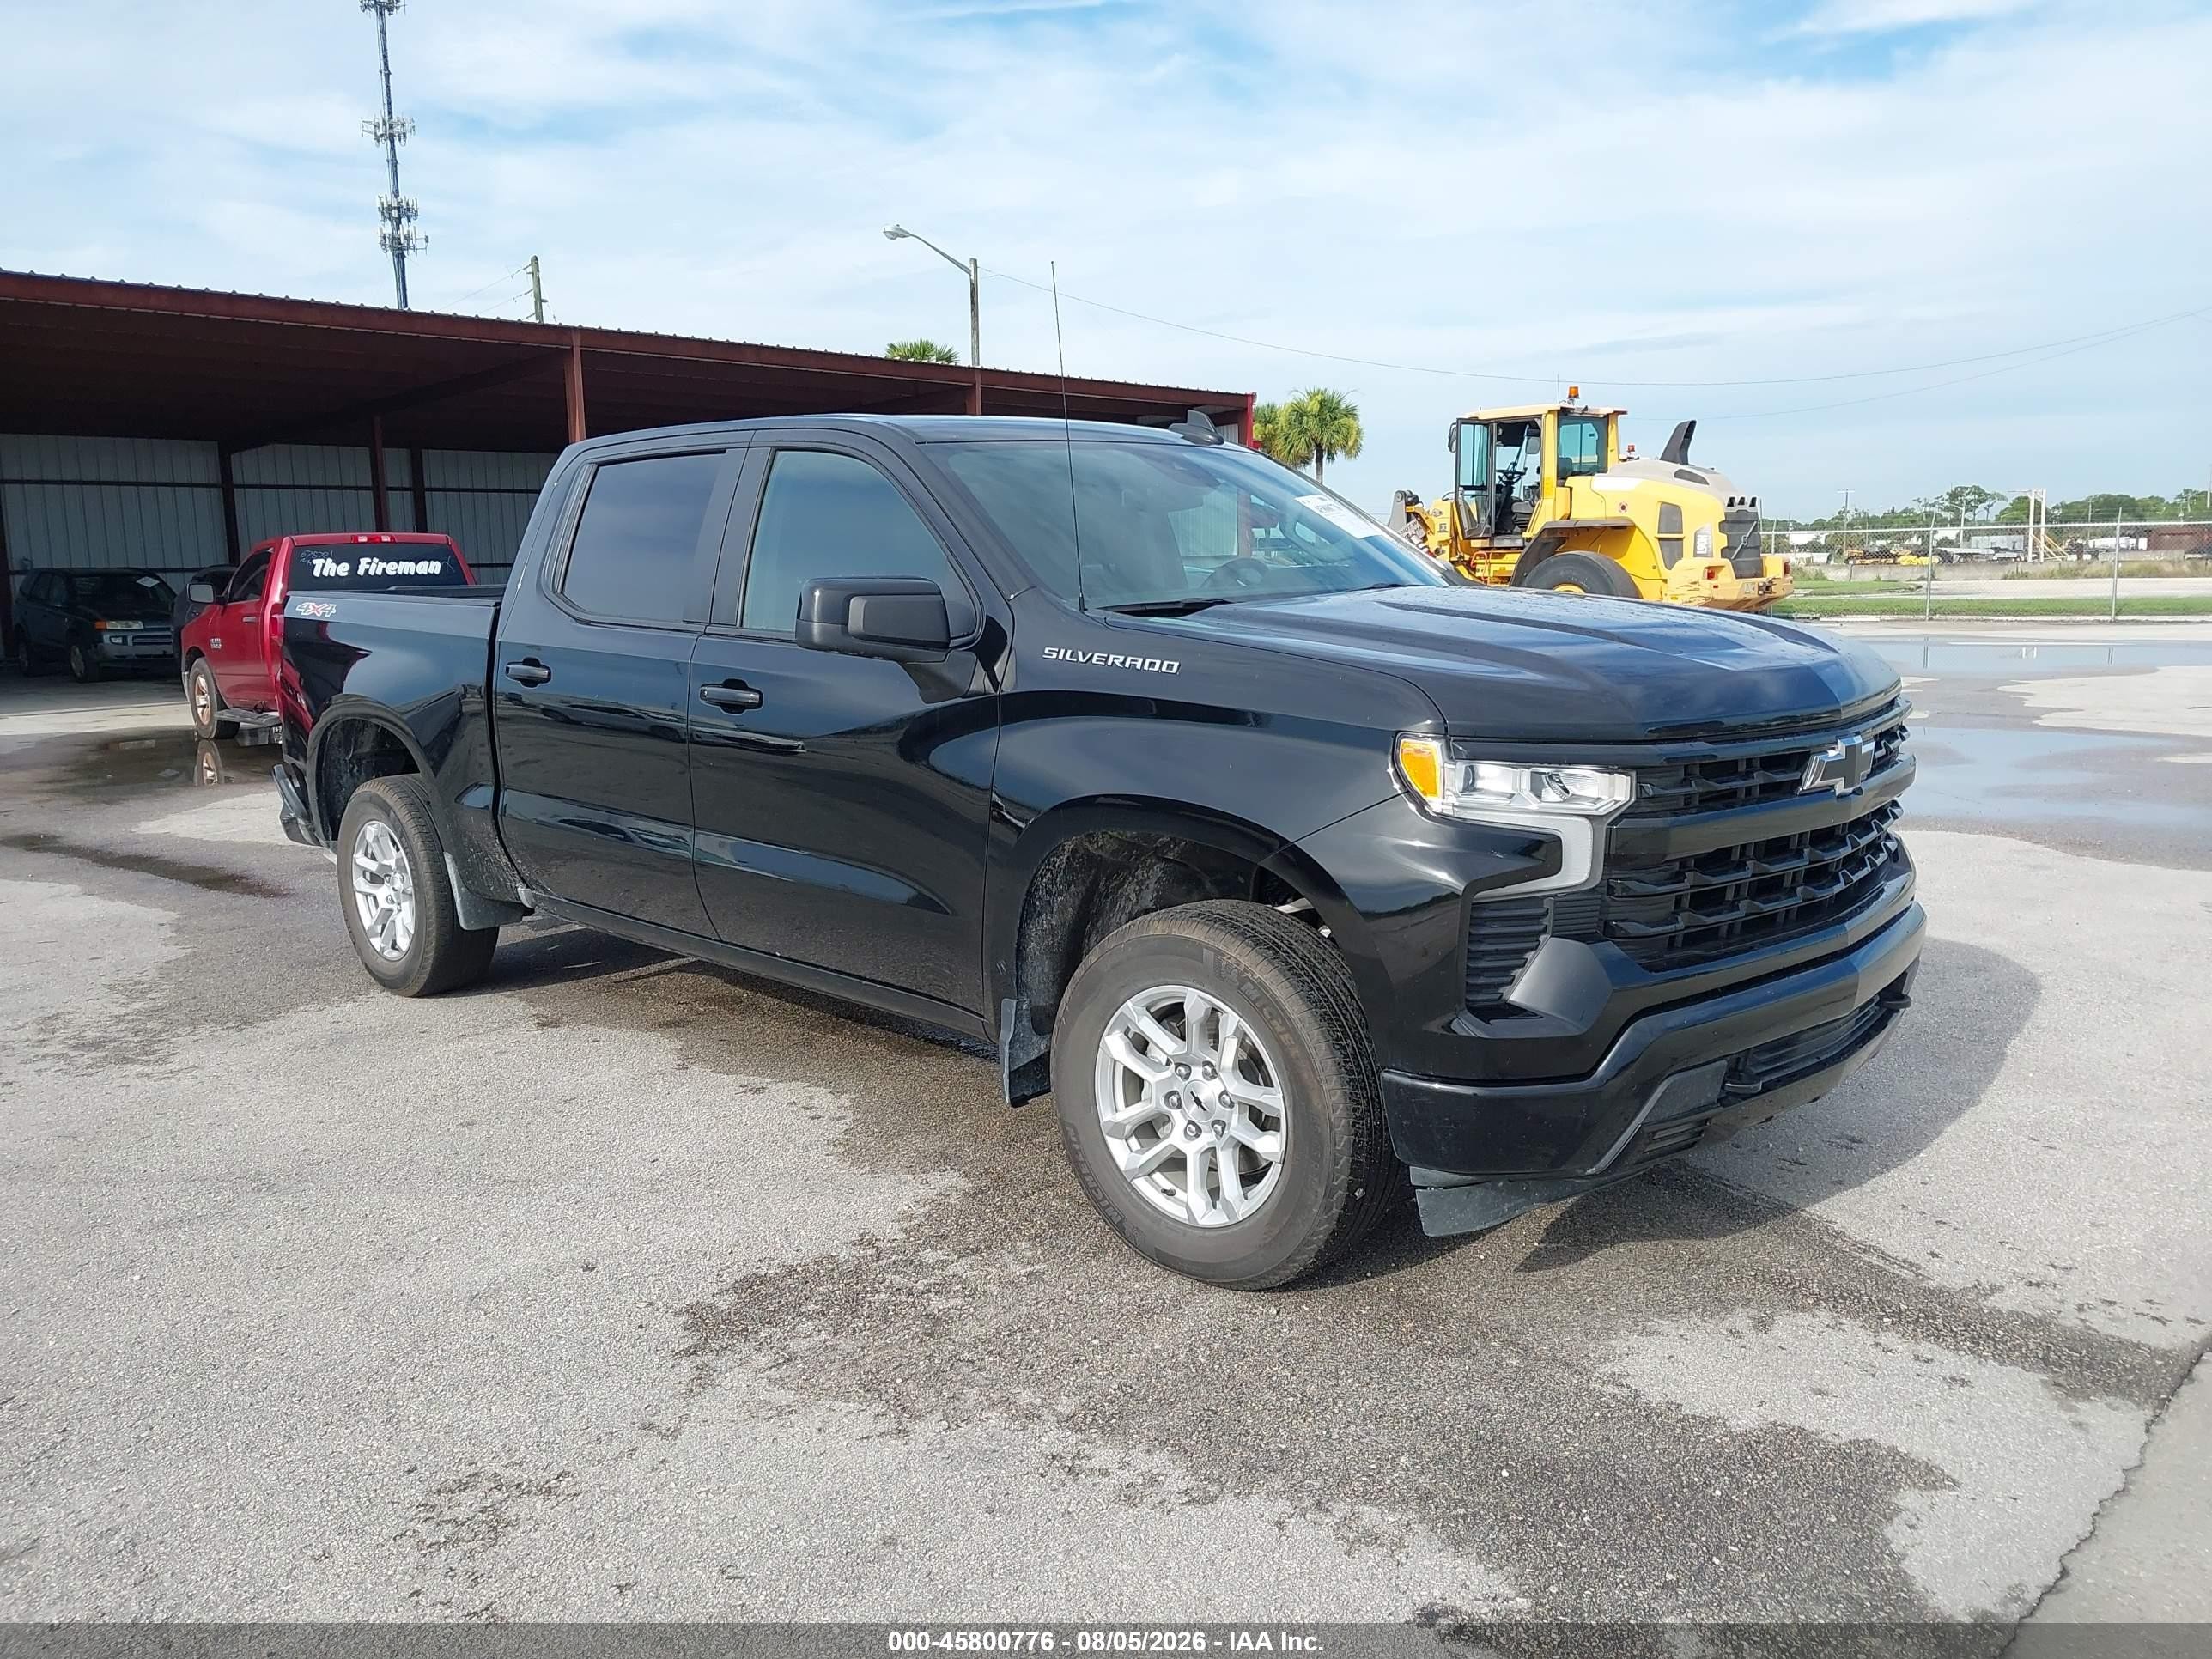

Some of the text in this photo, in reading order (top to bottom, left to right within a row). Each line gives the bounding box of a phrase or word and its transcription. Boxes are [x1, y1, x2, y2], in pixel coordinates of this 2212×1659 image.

[312, 556, 442, 578] The Fireman
[1042, 647, 1182, 675] SILVERADO
